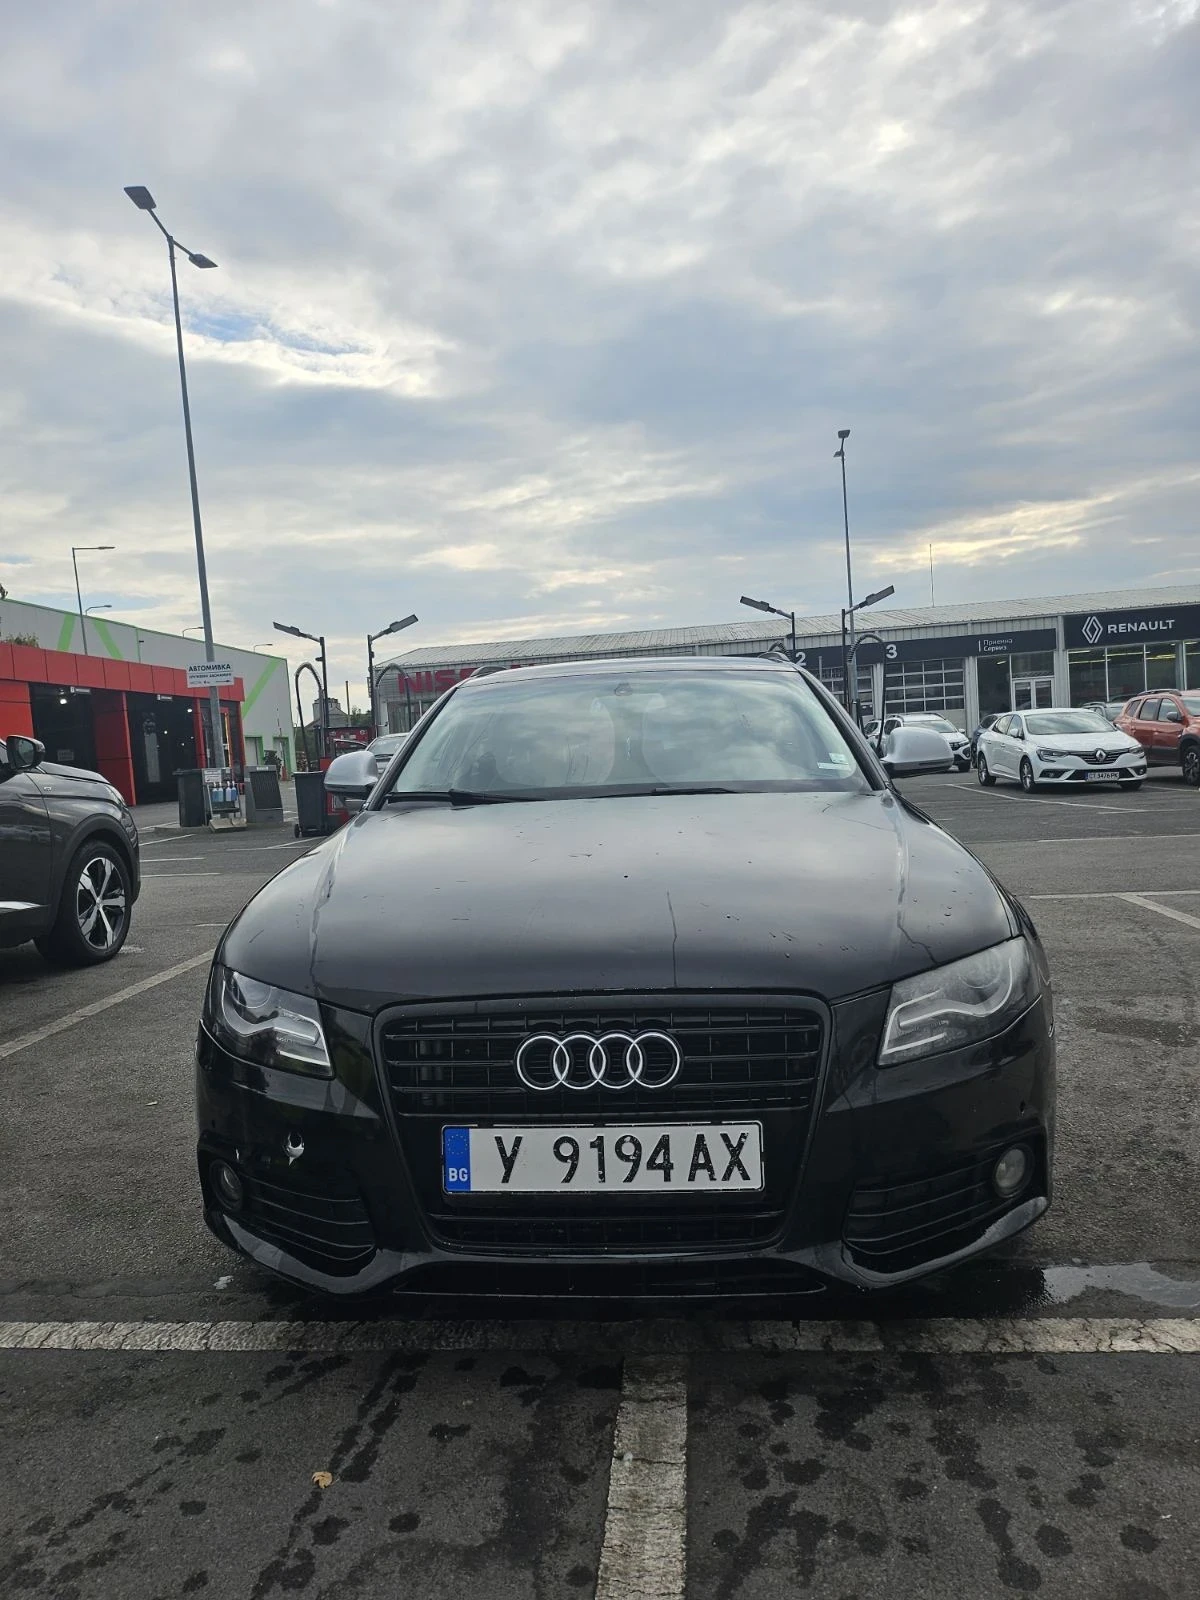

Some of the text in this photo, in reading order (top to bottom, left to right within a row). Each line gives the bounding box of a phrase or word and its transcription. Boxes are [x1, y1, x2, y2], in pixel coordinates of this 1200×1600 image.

[1107, 619, 1175, 634] RENAULT
[983, 638, 1013, 646] Приемна
[983, 645, 1007, 653] Сервиз
[885, 643, 898, 659] 3
[795, 651, 807, 667] 2
[188, 663, 231, 672] АВТОМИВКА
[448, 1168, 468, 1182] BG
